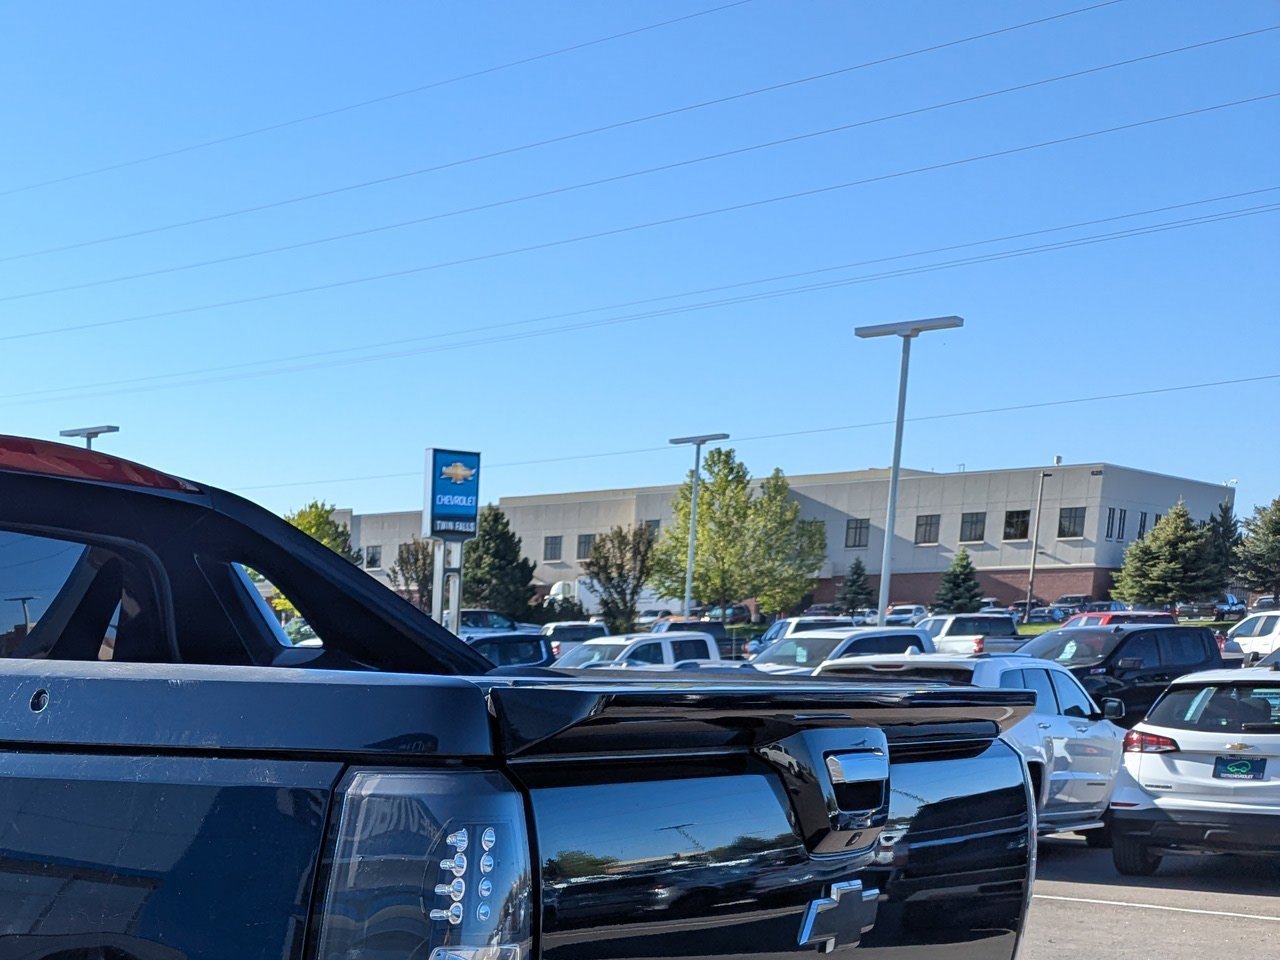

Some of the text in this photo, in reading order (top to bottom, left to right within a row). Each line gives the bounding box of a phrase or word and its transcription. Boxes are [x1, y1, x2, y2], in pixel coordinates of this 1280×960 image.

[436, 494, 476, 506] CHEVROLET
[436, 520, 475, 532] TWIN FALLS
